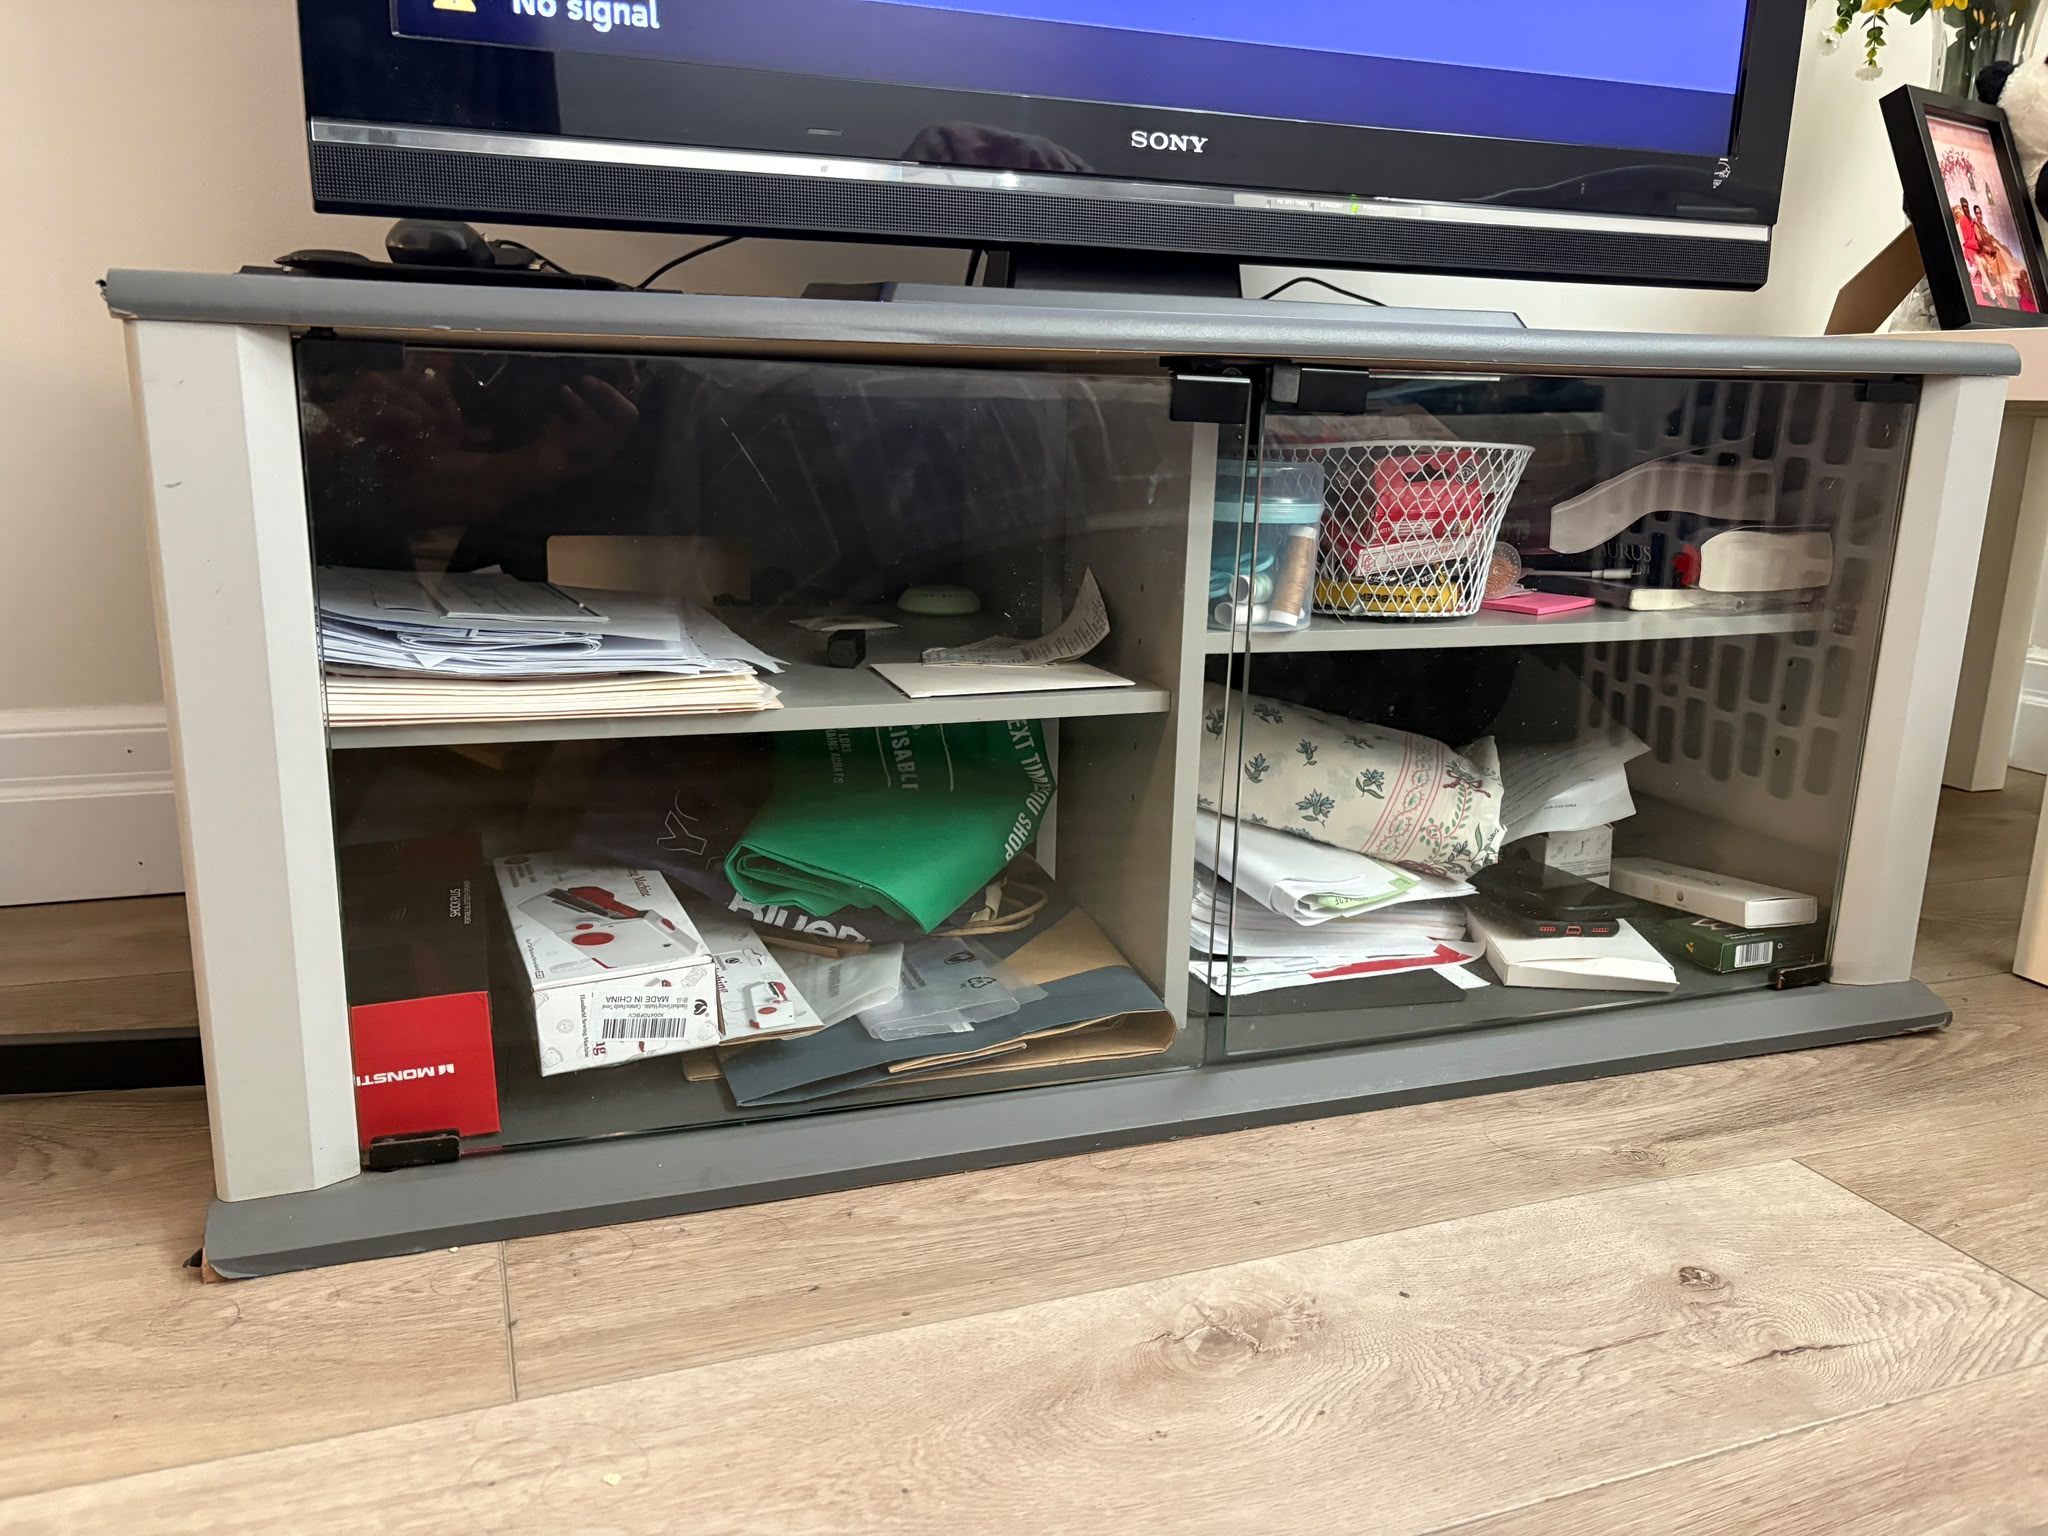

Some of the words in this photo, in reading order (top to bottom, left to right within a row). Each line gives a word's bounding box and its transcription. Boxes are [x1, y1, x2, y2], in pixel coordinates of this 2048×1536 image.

[512, 0, 558, 17] No
[566, 0, 661, 33] signal
[1131, 130, 1208, 153] SONY
[1007, 719, 1035, 750] EXT
[1004, 812, 1032, 861] SHOP
[605, 995, 633, 1003] CHINA
[645, 995, 670, 1004] MADE
